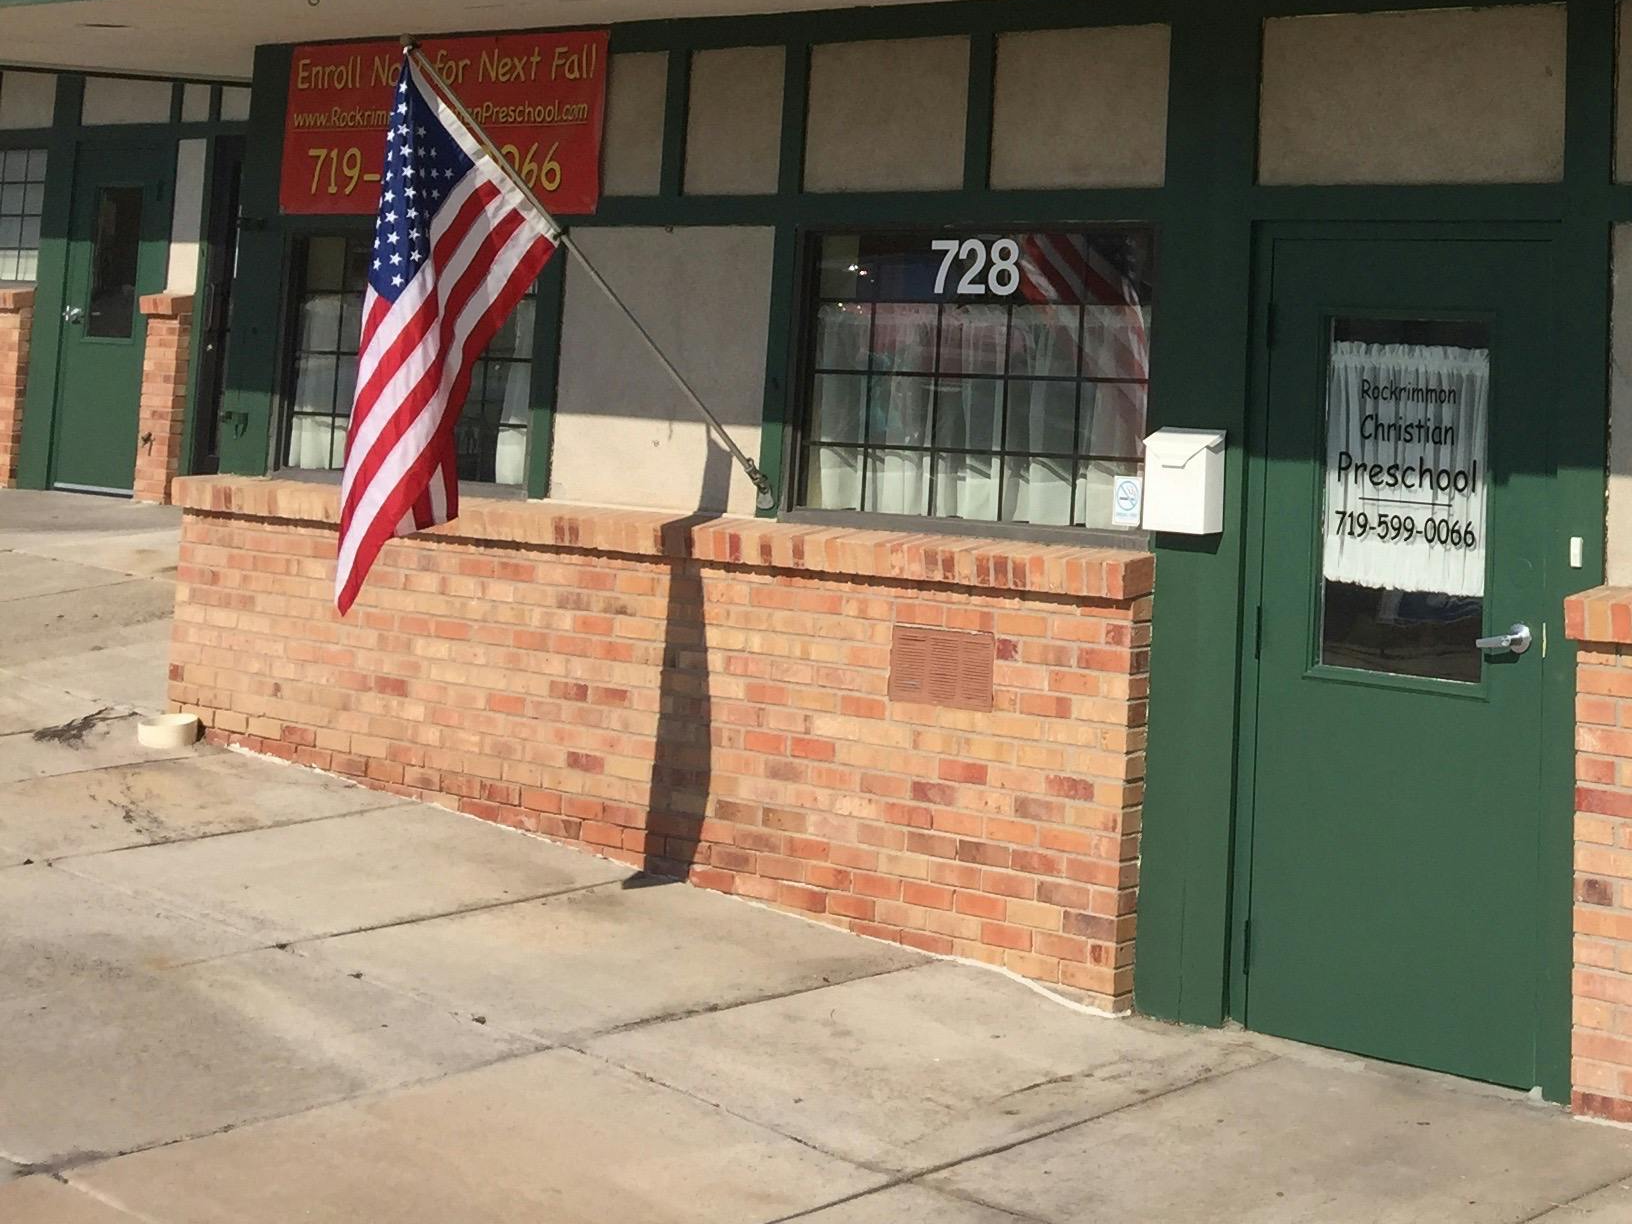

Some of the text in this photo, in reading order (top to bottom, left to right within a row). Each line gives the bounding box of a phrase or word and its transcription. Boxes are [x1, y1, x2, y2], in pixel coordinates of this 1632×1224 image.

[297, 43, 597, 90] Enroll No for Next Fall
[931, 238, 1020, 296] 728
[1361, 379, 1456, 405] Rockrimmon
[1360, 414, 1455, 446] Christian
[1337, 451, 1477, 493] Preschool
[1335, 510, 1476, 547] 719-599-0066
